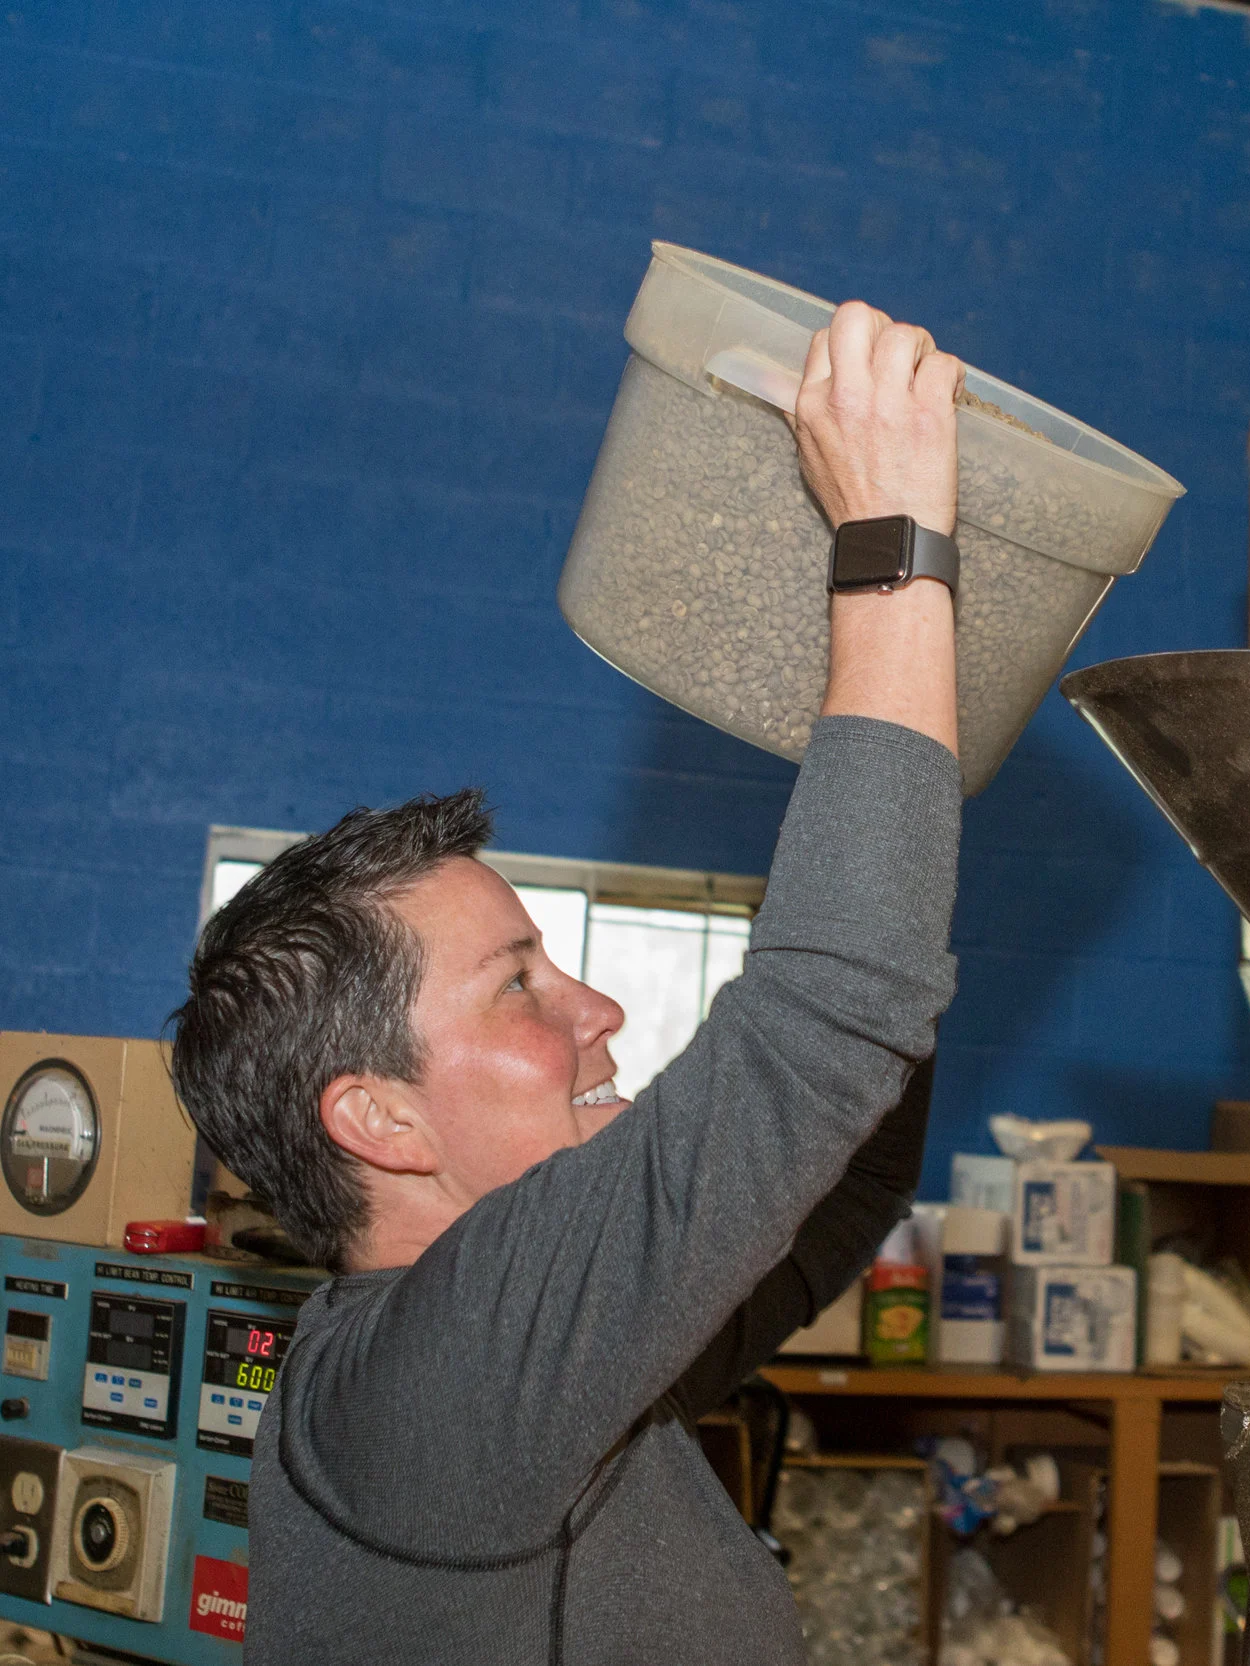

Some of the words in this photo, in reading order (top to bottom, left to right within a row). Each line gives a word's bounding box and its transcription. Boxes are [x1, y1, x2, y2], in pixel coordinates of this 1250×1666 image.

[161, 1272, 189, 1287] CONTROL
[247, 1329, 274, 1356] 02
[236, 1363, 276, 1392] 600
